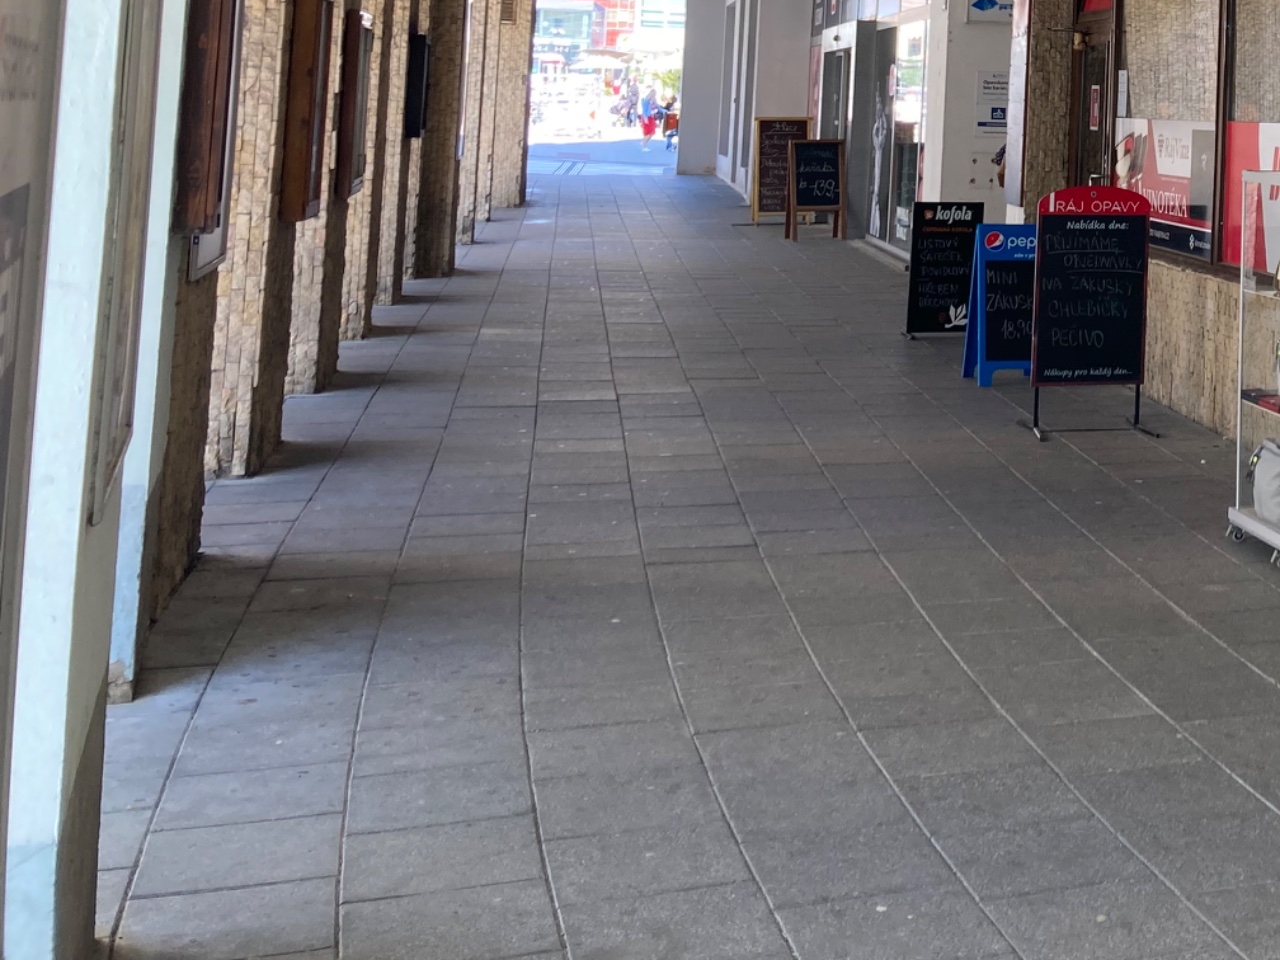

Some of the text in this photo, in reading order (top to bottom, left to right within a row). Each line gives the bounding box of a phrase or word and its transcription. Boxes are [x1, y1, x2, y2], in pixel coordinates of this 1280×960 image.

[1056, 200, 1140, 213] RÁJ OPAVY
[935, 205, 972, 225] kofola
[1066, 220, 1105, 230] Nabídka
[986, 268, 1018, 285] MINI
[1042, 276, 1063, 291] NA
[1051, 322, 1105, 349] PEČIVO
